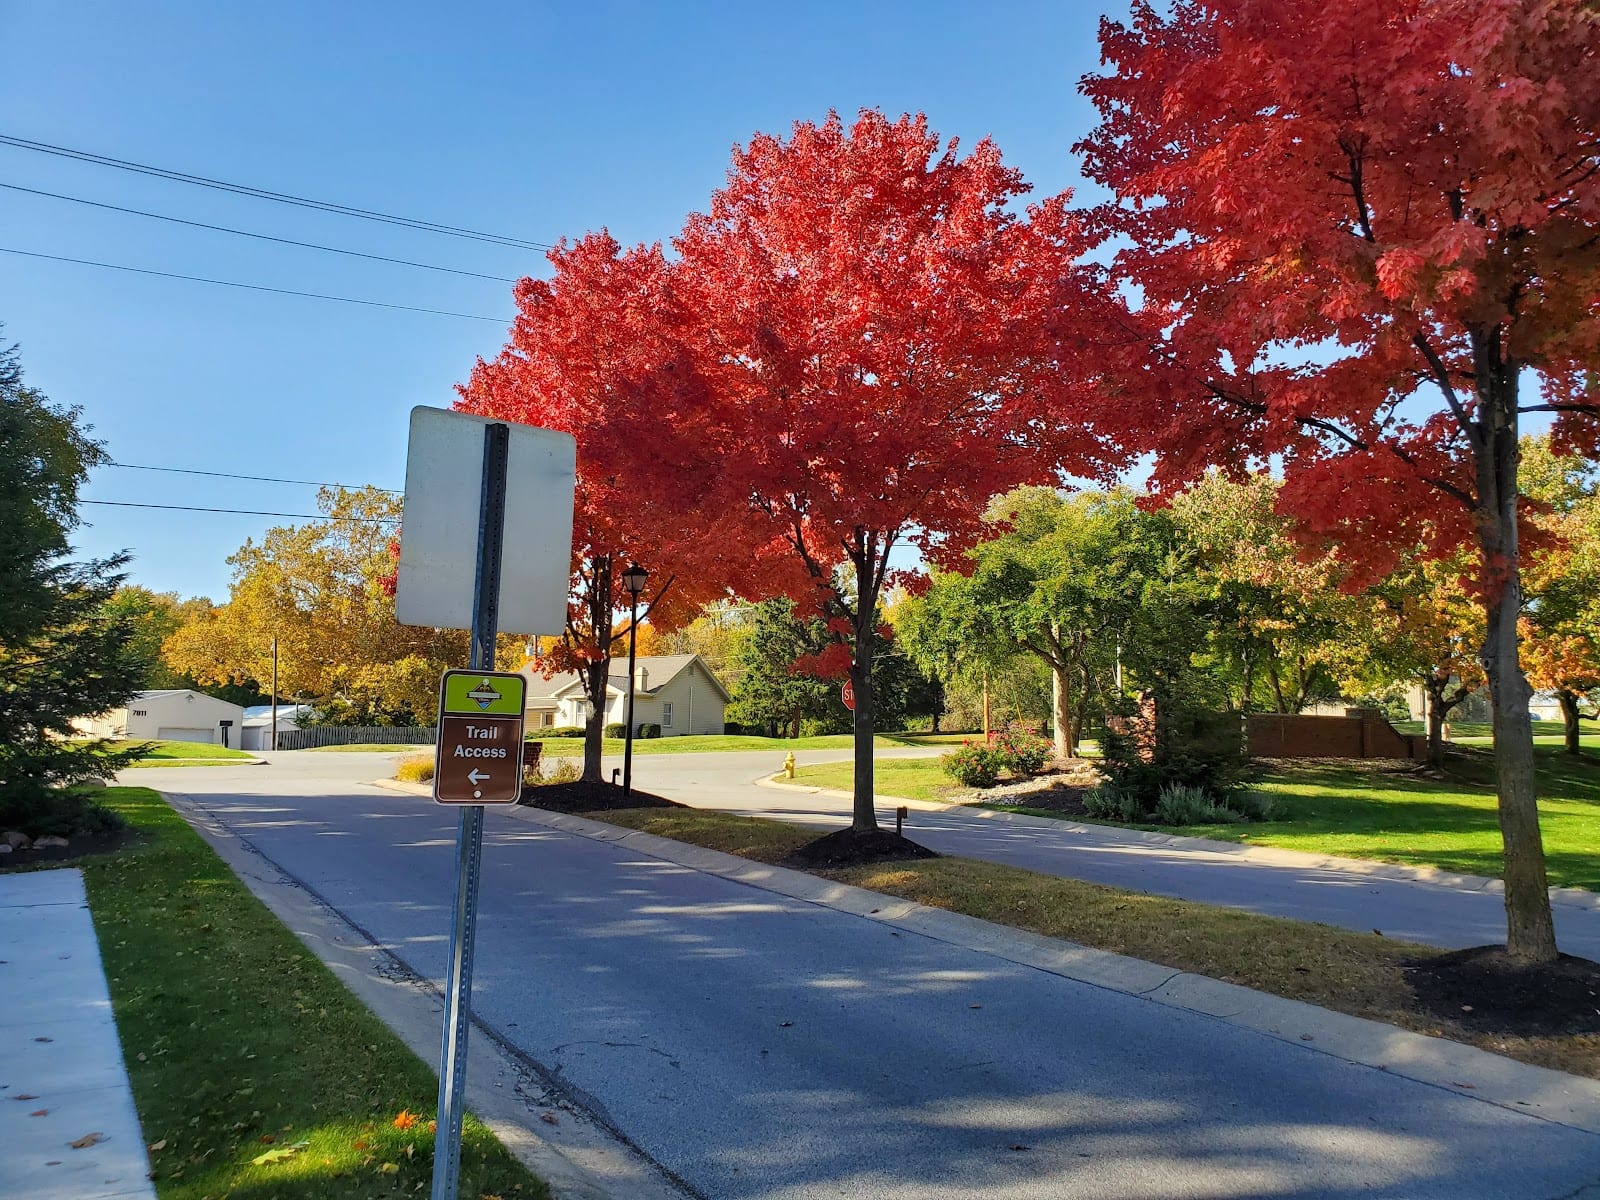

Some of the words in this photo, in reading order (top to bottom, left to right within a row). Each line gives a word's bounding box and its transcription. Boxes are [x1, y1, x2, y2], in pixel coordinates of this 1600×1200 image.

[844, 689, 853, 701] ST
[466, 725, 498, 739] Trail
[453, 744, 507, 758] Access
